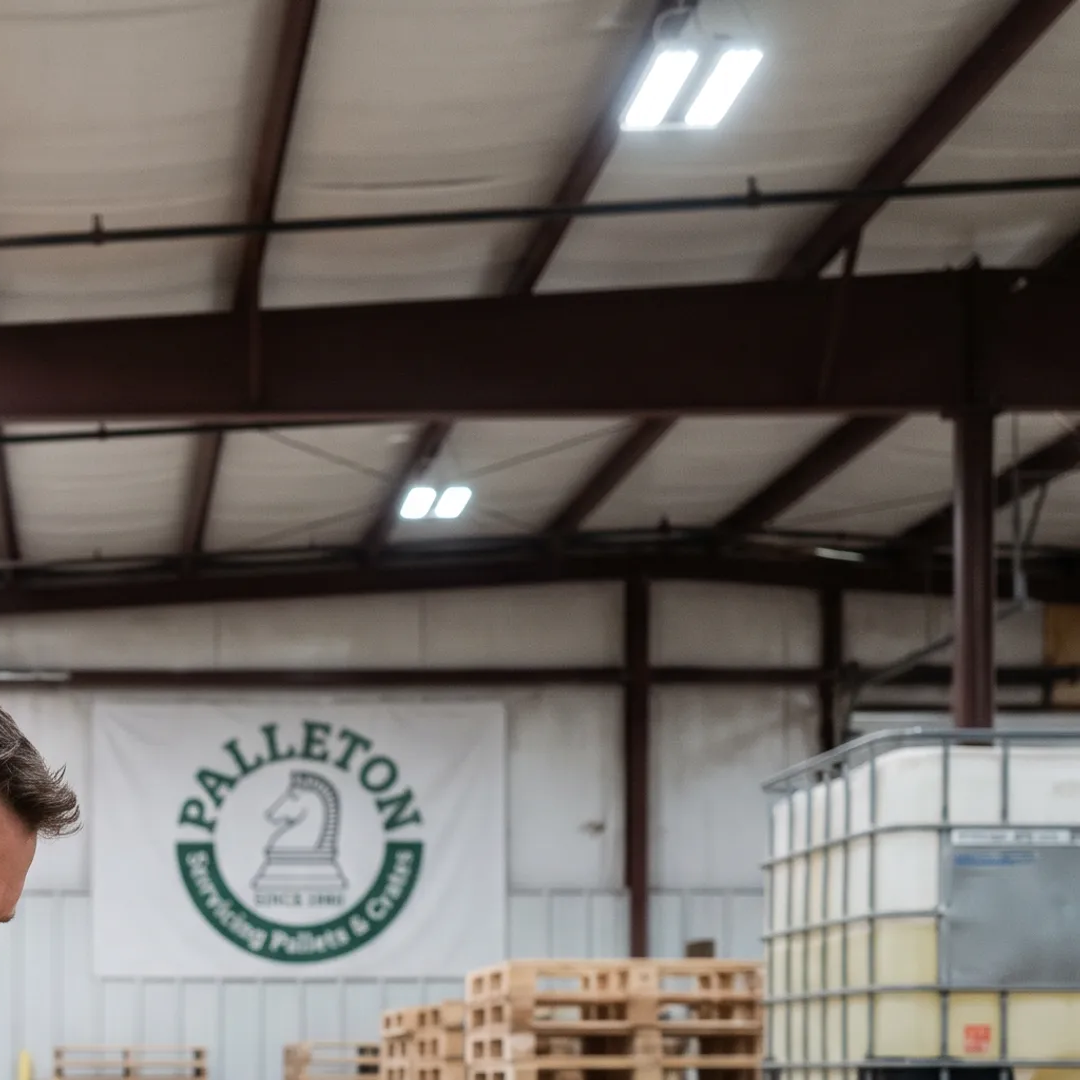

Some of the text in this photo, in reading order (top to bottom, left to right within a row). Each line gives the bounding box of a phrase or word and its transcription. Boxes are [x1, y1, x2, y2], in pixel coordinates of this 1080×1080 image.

[177, 718, 424, 834] PALLETON
[269, 927, 350, 955] Pallets
[348, 914, 371, 937] &
[364, 850, 416, 922] Crates
